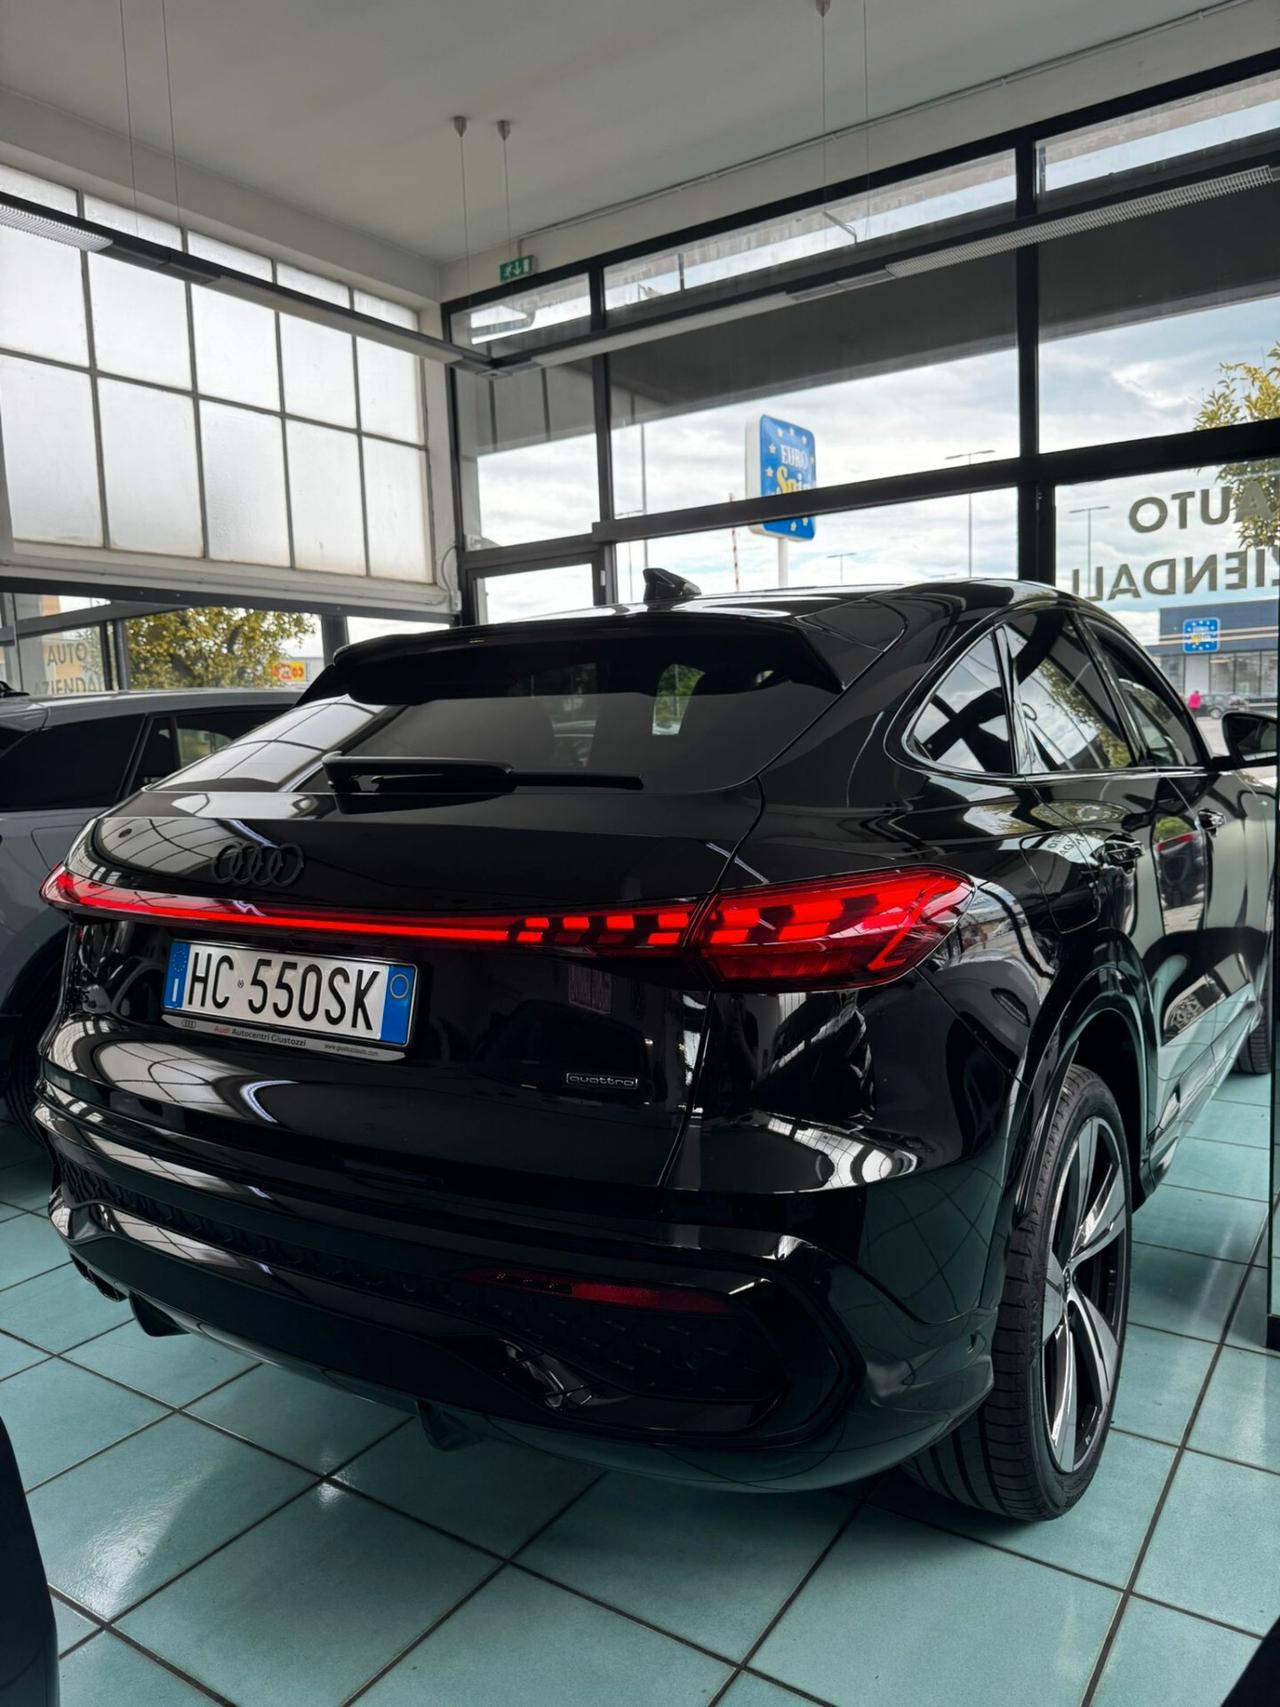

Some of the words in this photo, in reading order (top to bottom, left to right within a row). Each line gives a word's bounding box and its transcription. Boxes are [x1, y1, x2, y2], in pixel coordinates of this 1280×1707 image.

[47, 642, 88, 666] AUTO
[188, 952, 235, 1009] HC
[247, 958, 381, 1031] 550SK
[231, 1028, 270, 1041] Autocentri
[271, 1034, 307, 1047] Giustozzi
[569, 1075, 635, 1087] quattro
